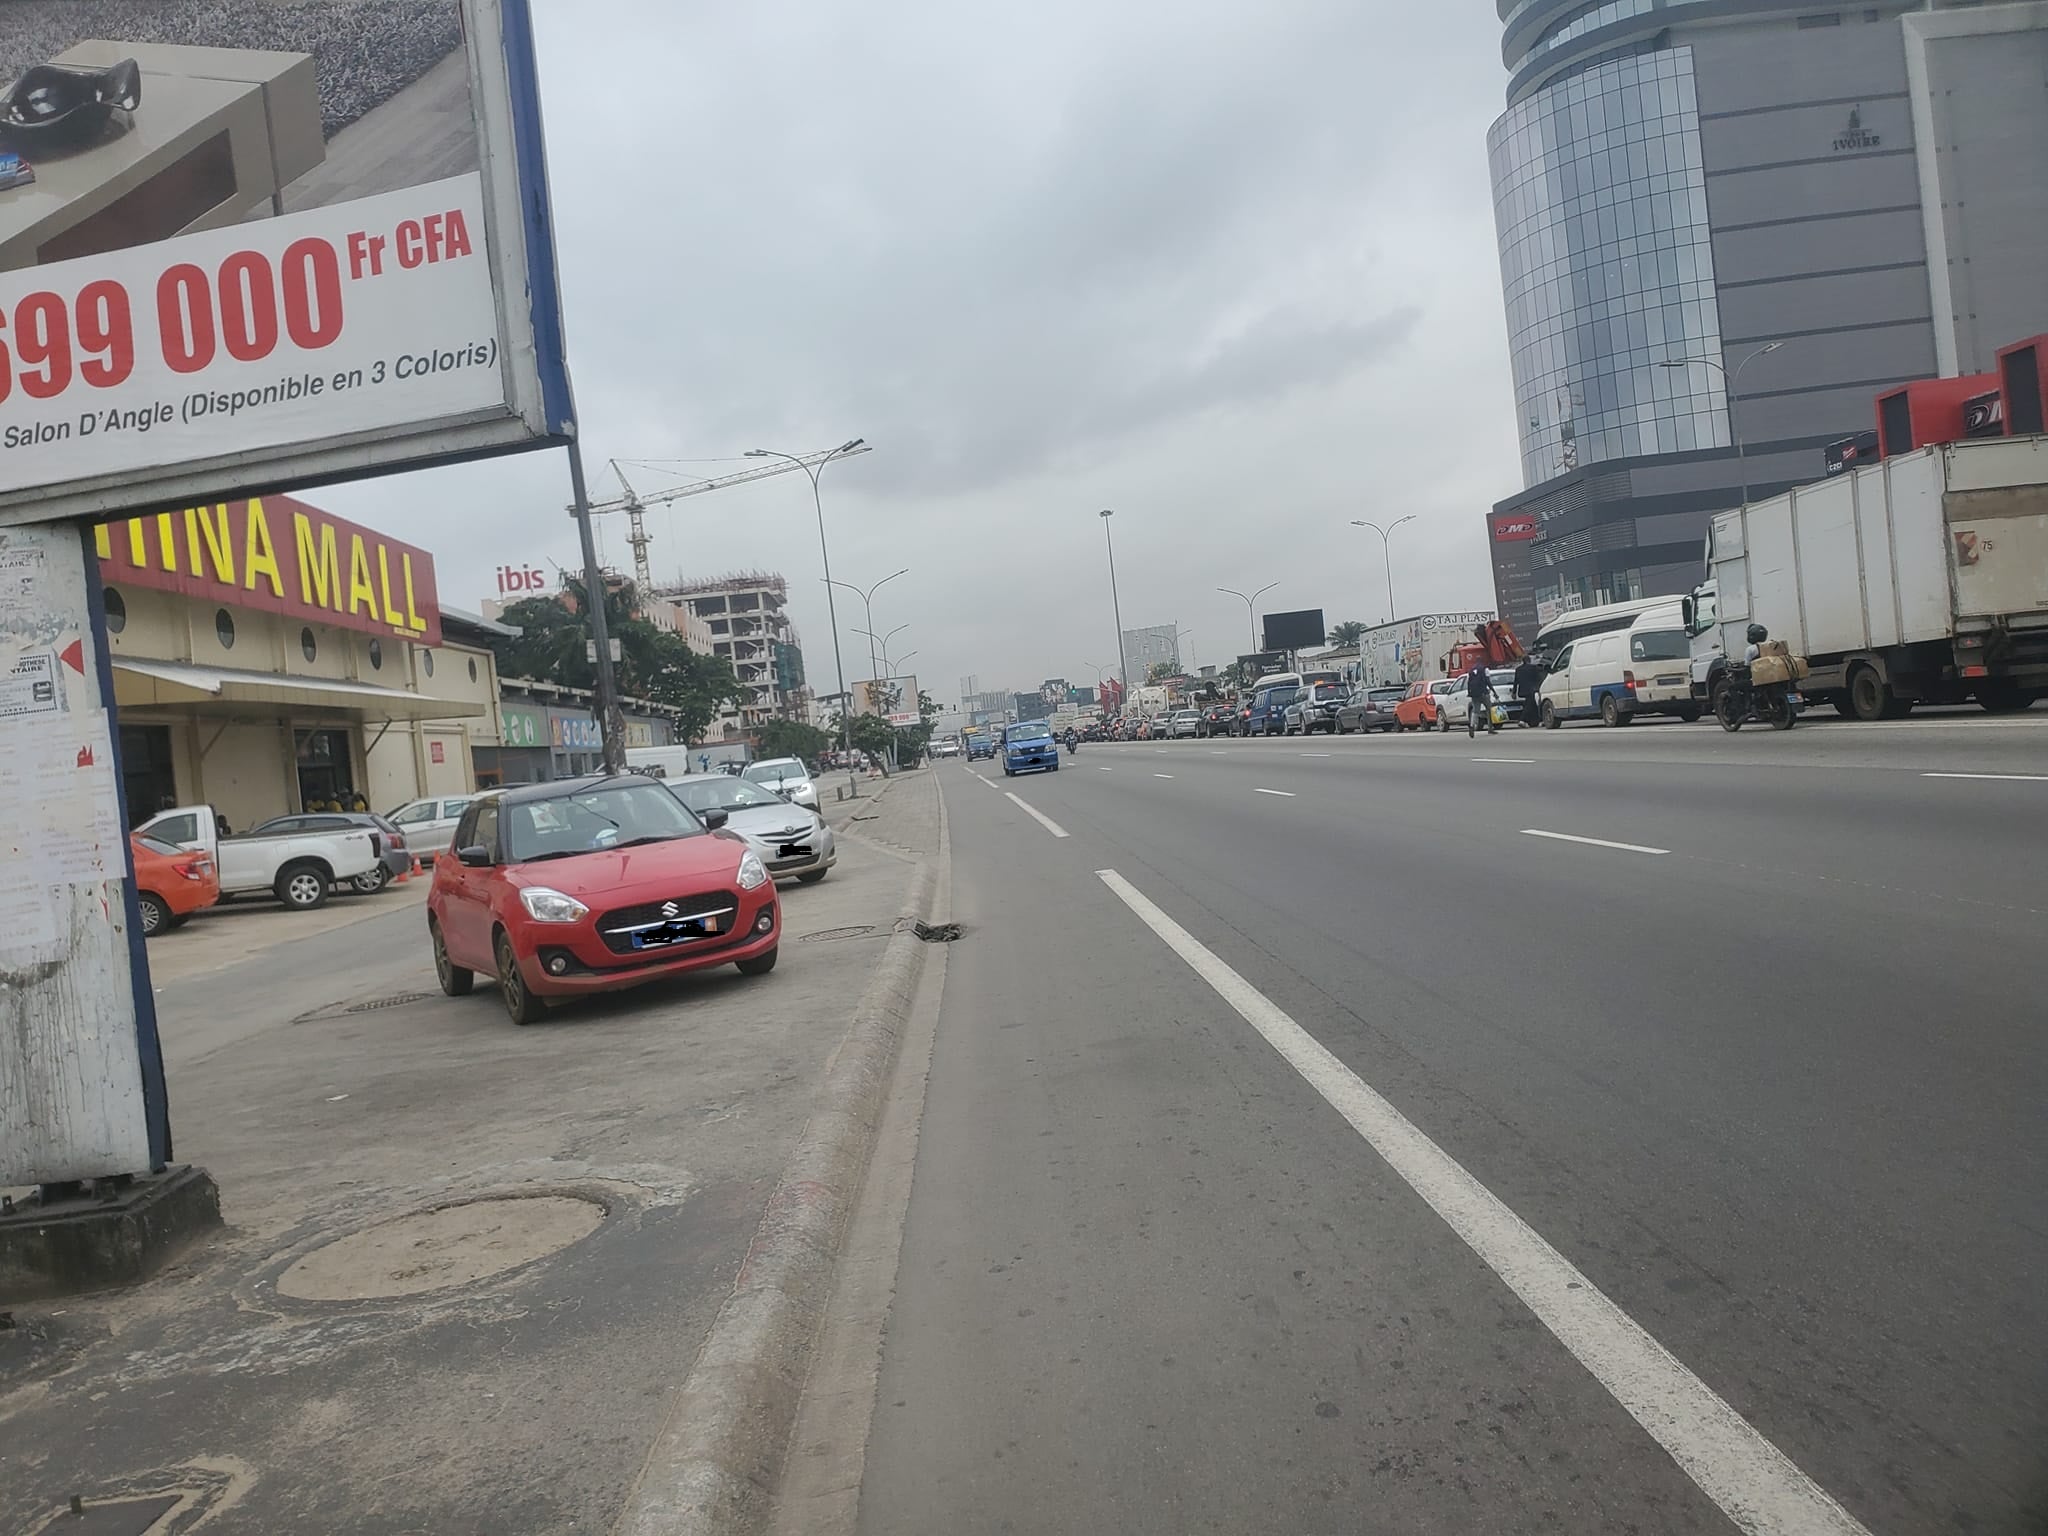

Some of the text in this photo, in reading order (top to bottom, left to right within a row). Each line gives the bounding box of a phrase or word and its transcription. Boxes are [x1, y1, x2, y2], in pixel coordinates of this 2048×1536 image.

[1832, 136, 1880, 151] IVOIRE
[0, 209, 472, 405] 99 000 Fr CFA
[4, 337, 498, 449] Salon D'Angle (Disponible en 3 Coloris)
[1497, 523, 1533, 536] DMD
[293, 511, 427, 632] MALL
[496, 564, 545, 592] ibis
[1437, 611, 1494, 624] TAJ PLAST
